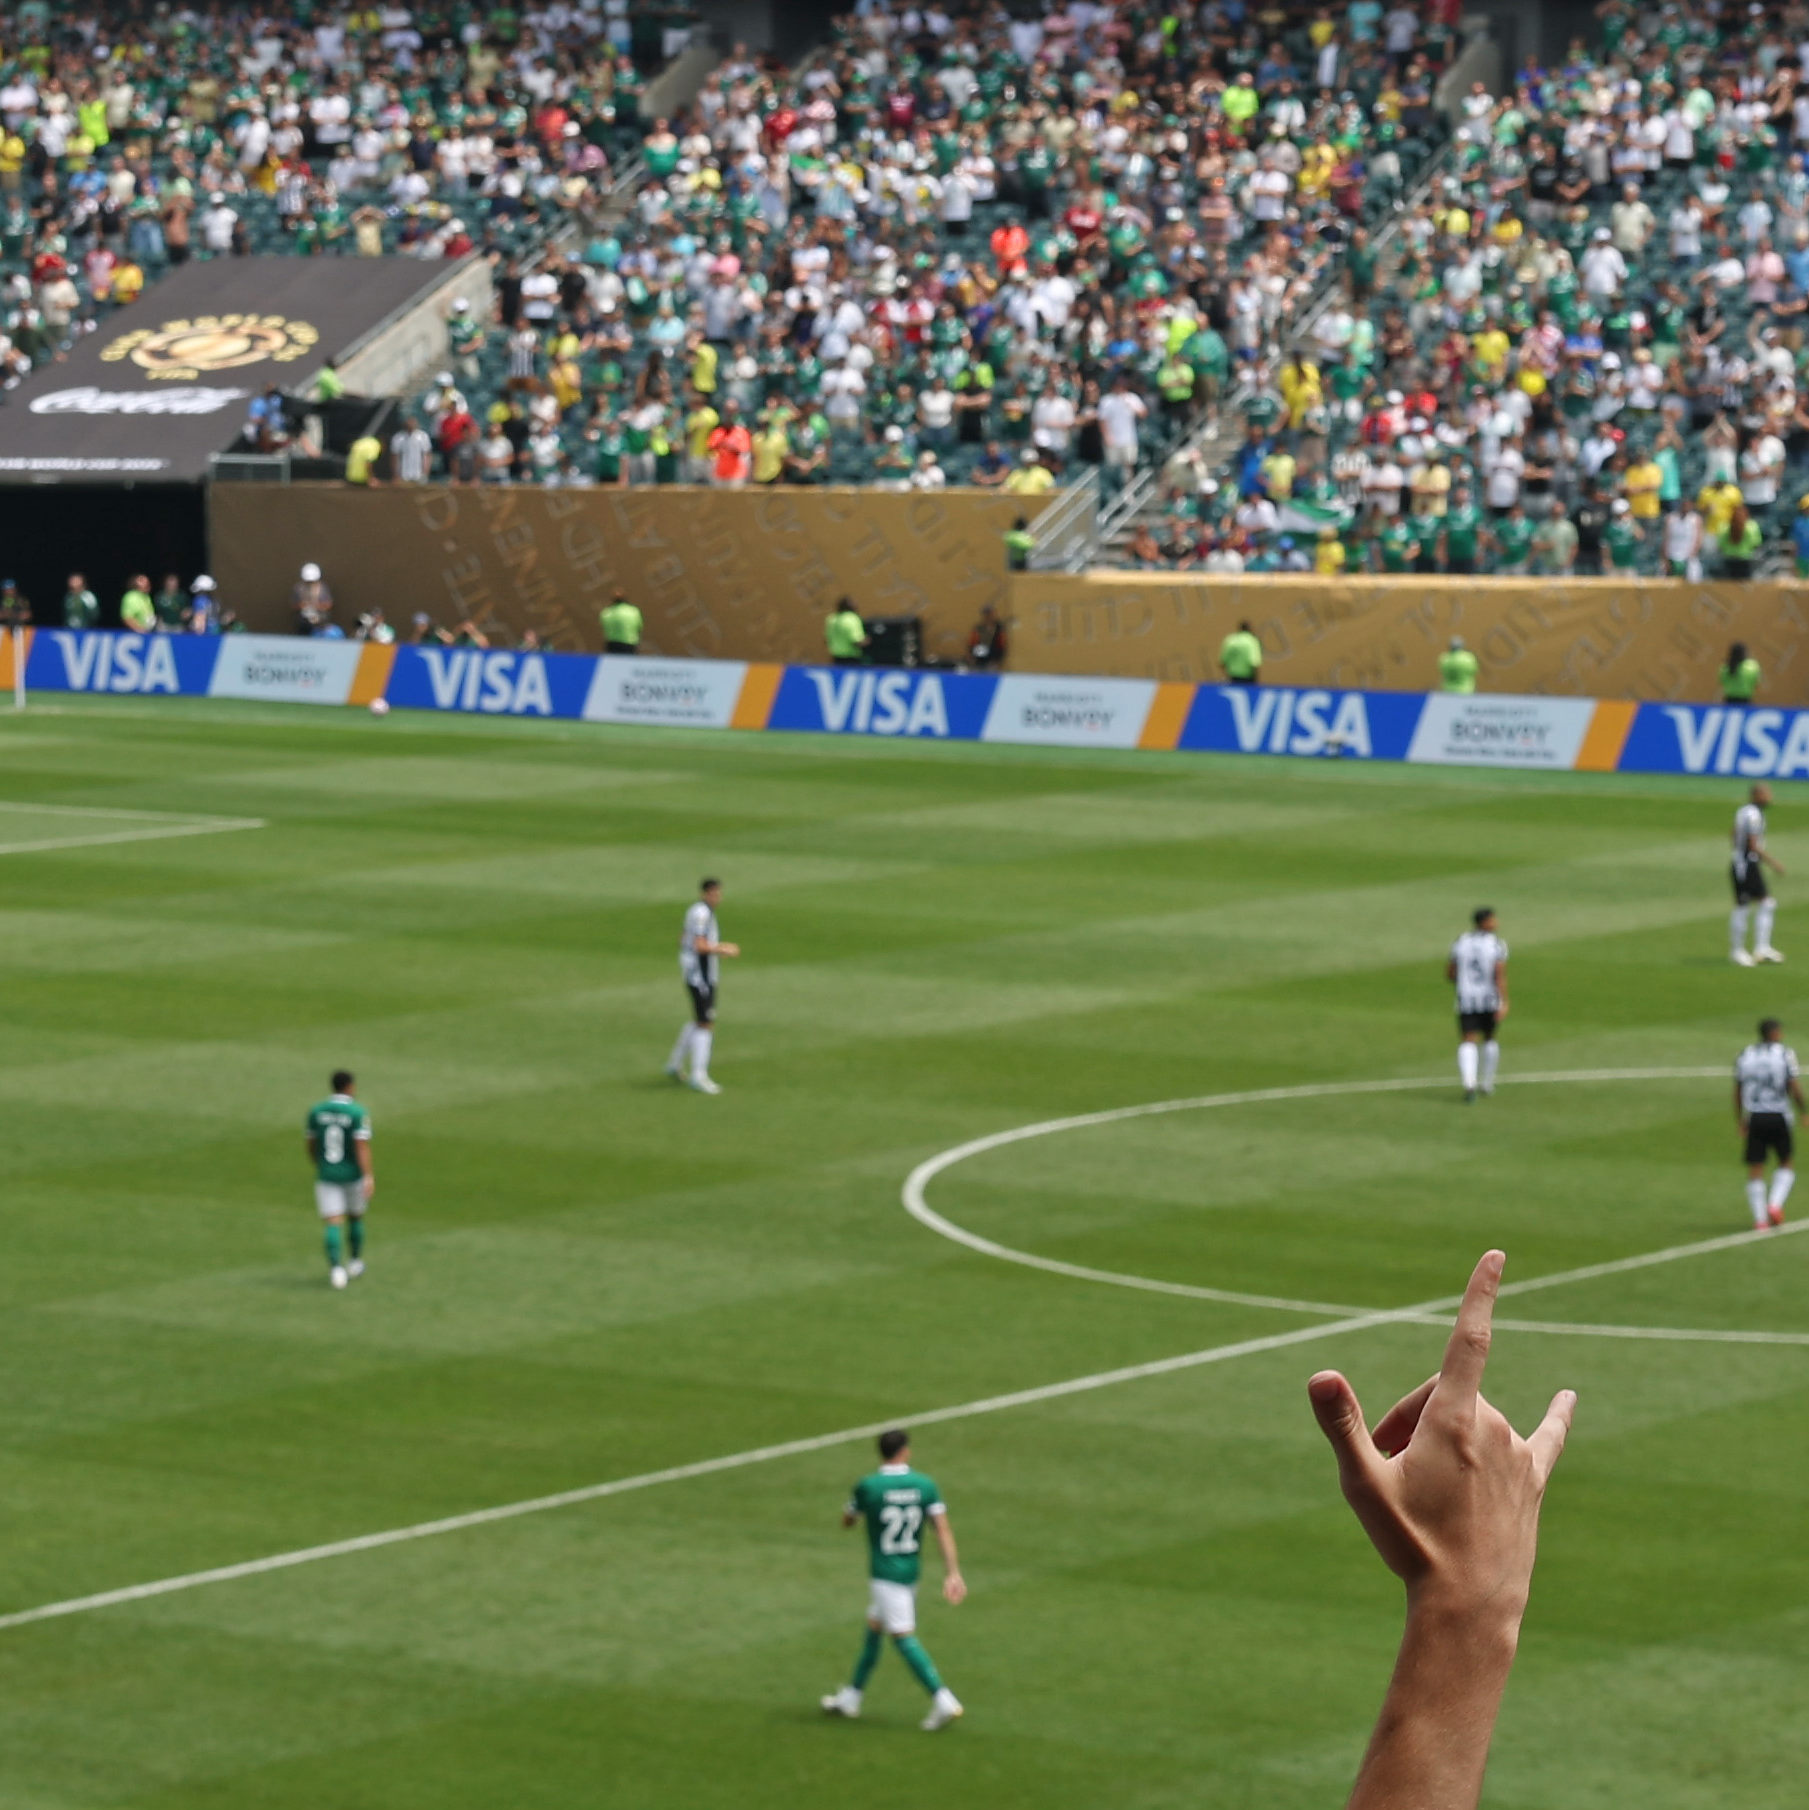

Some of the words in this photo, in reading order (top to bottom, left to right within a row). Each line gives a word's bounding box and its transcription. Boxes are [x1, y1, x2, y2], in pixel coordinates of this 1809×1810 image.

[52, 631, 181, 695] VISA
[415, 648, 554, 714] VISA
[806, 669, 950, 735] VISA
[1220, 688, 1374, 757] VISA
[879, 1504, 923, 1555] 22
